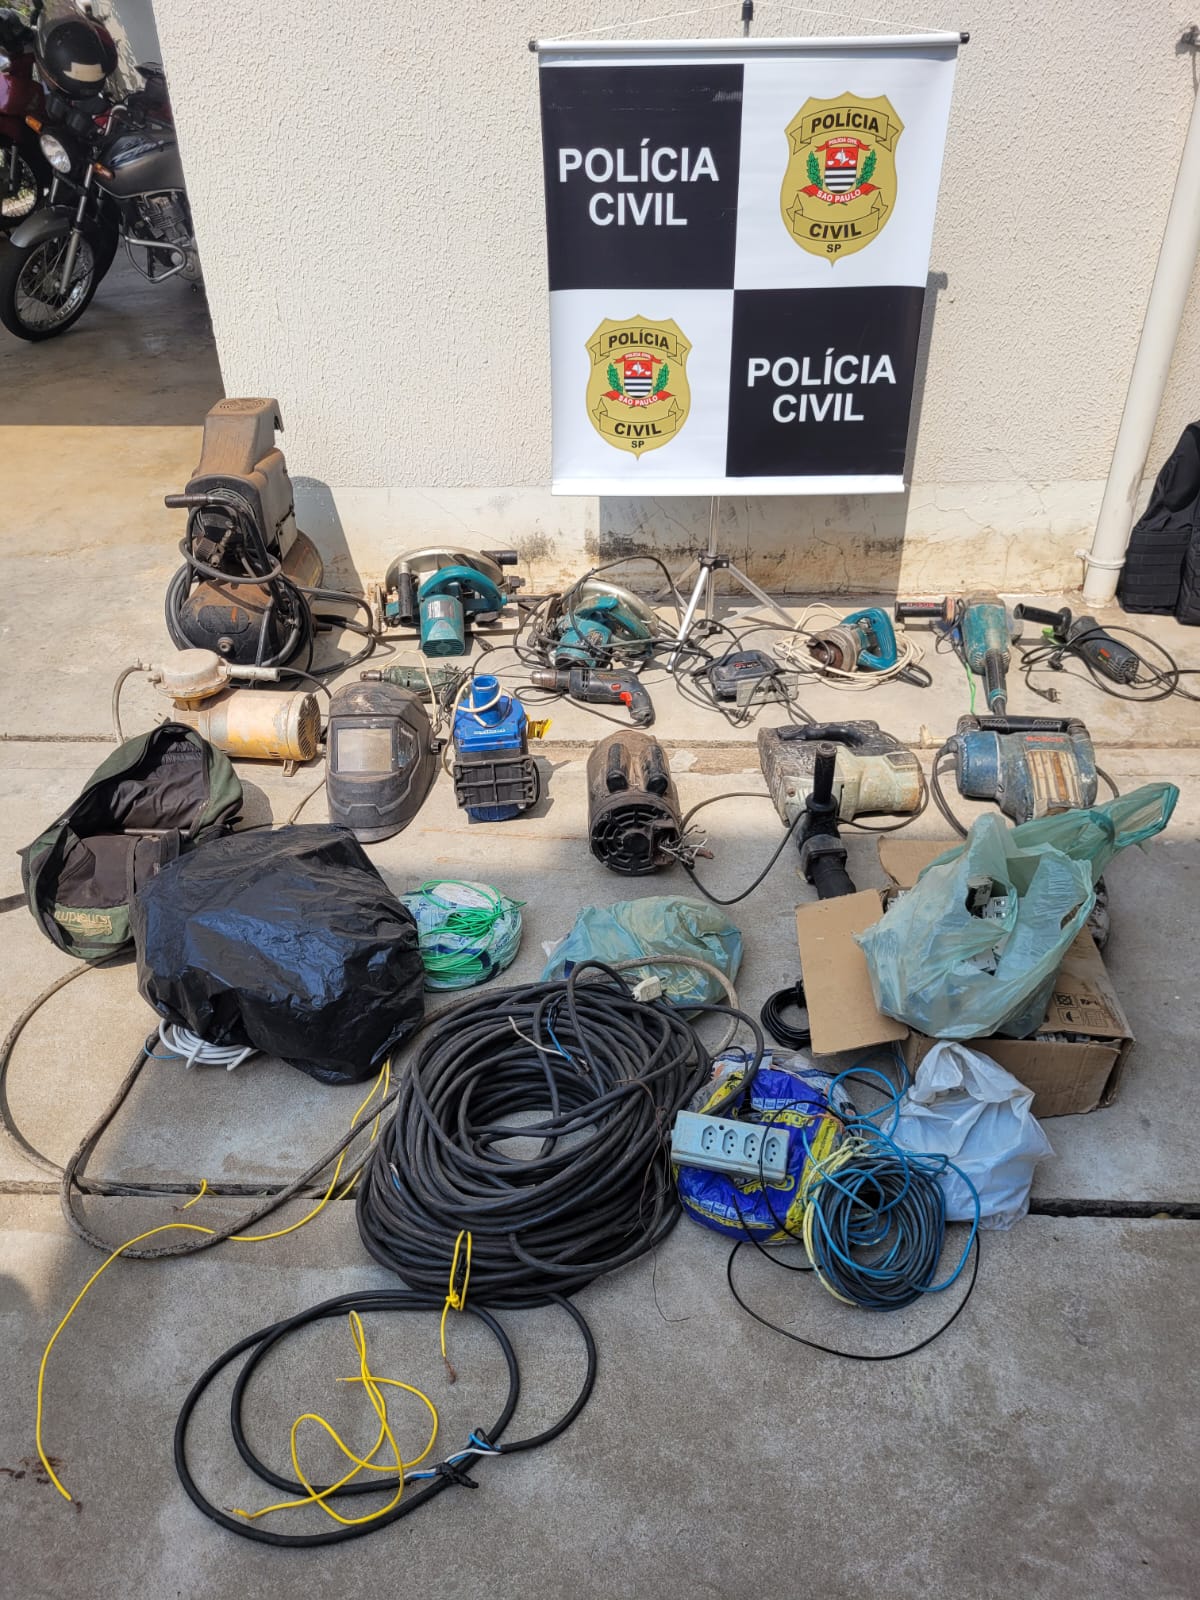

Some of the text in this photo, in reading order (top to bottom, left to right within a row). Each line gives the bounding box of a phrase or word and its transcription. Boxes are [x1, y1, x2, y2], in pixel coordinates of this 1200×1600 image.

[811, 109, 879, 133] POLÍCIA
[559, 138, 720, 184] POLÍCIA
[834, 188, 861, 203] PAULO
[588, 193, 688, 227] CIVIL
[809, 222, 862, 240] CIVIL
[826, 243, 842, 254] SP
[608, 329, 669, 350] POLÍCIA
[747, 348, 897, 388] POLÍCIA
[634, 394, 658, 406] PAULO
[772, 393, 865, 424] CIVIL
[614, 422, 662, 437] CIVIL
[631, 440, 645, 449] SP
